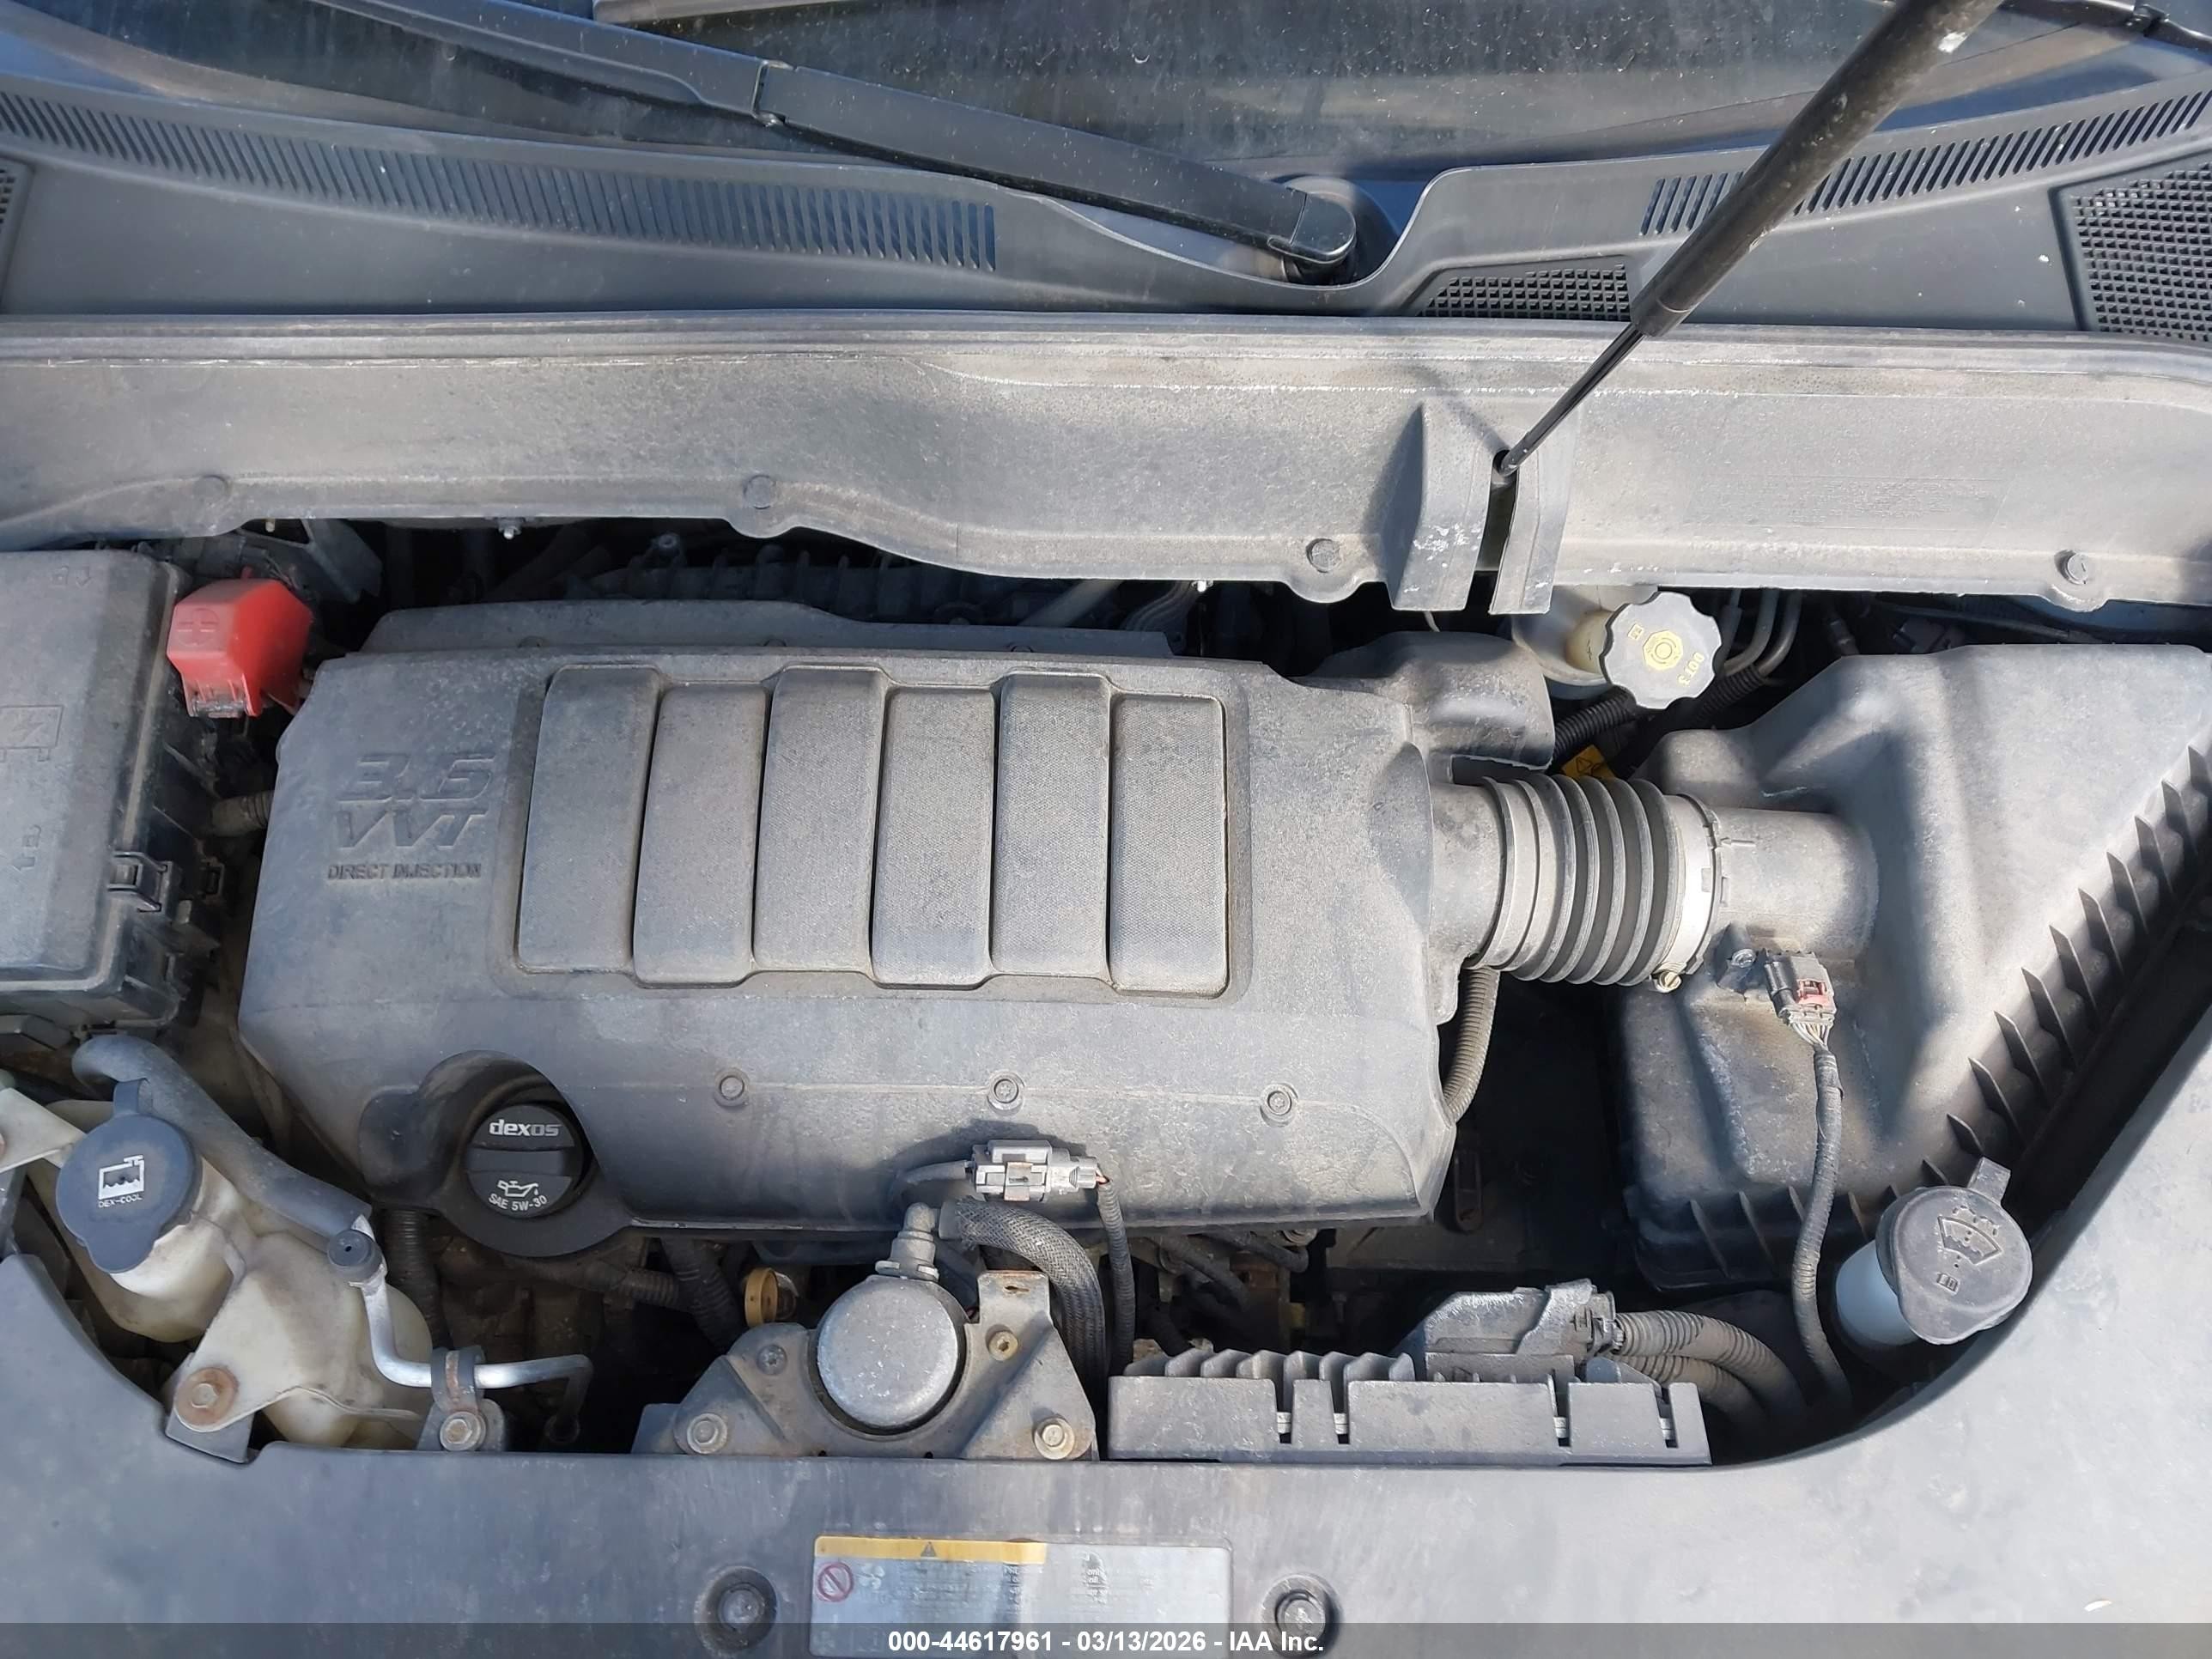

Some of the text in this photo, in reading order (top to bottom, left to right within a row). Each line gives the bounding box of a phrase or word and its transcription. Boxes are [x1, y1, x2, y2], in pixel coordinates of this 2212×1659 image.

[1677, 652, 1705, 688] DOT 3
[338, 752, 495, 803] 3.6
[336, 808, 490, 849] VVT
[327, 862, 483, 880] DIRECT INJECTION
[489, 1119, 562, 1137] dexos
[98, 1194, 143, 1208] DEX-COOL
[488, 1193, 548, 1212] SAE 5W-30
